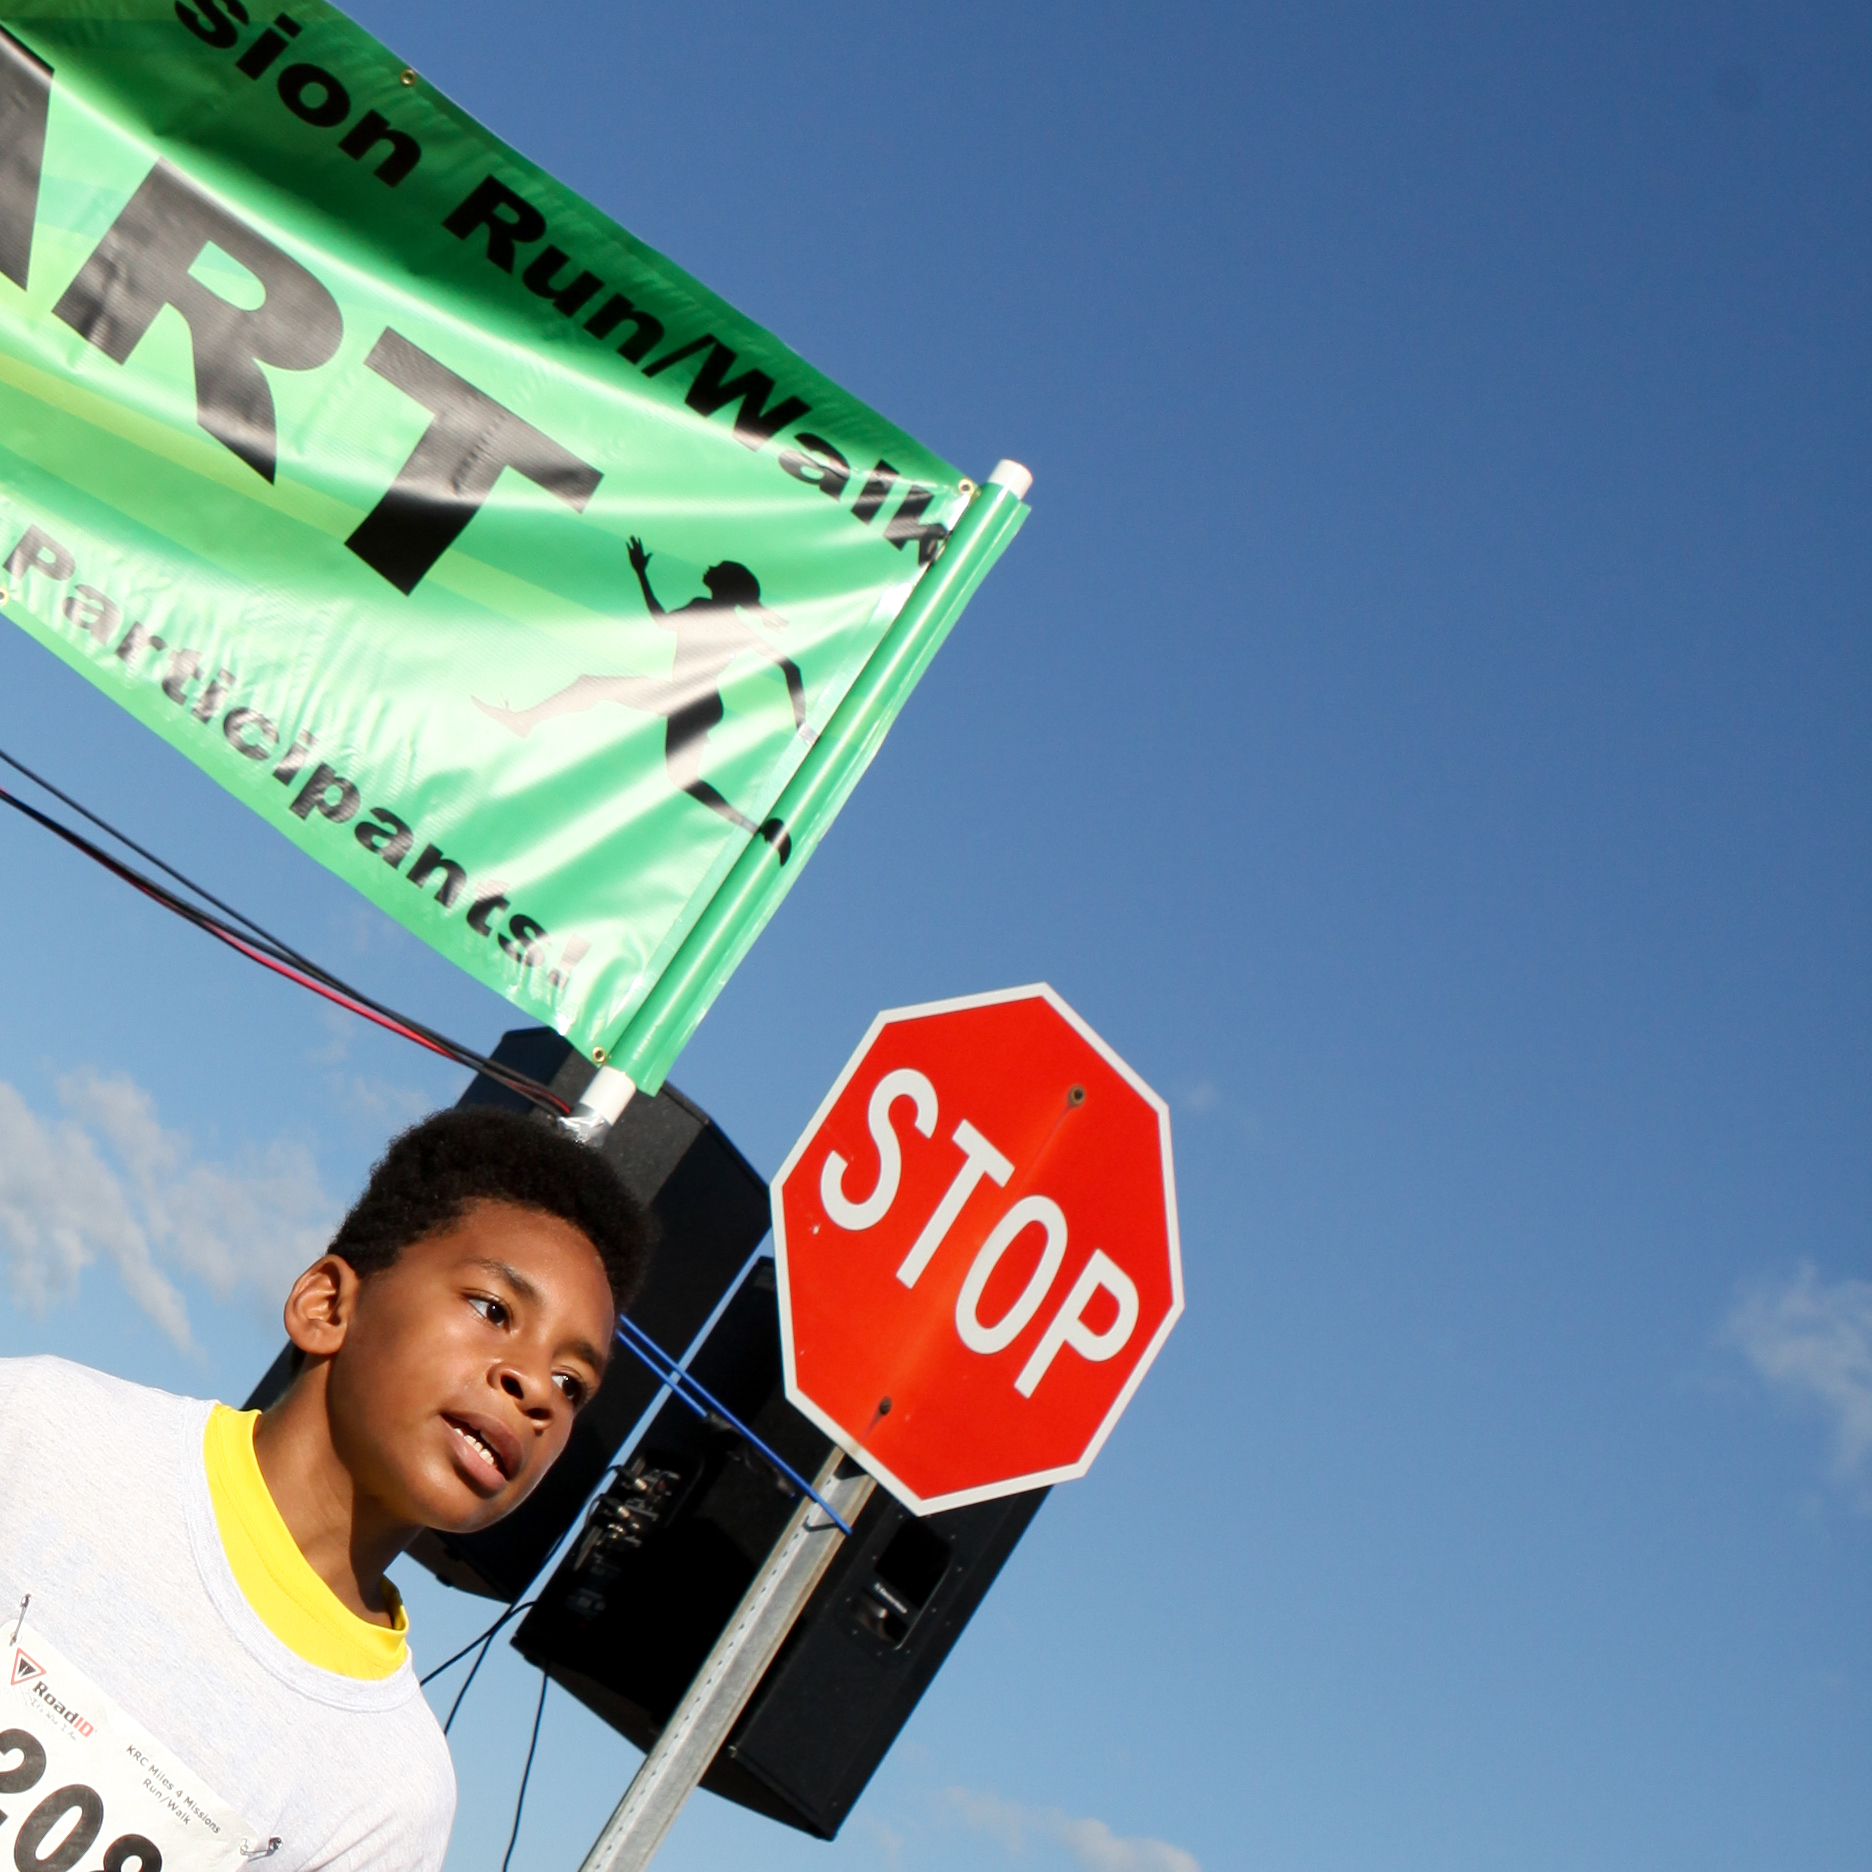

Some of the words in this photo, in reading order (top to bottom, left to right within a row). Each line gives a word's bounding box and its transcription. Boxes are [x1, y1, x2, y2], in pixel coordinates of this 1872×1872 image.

[440, 174, 950, 567] Run/Walk
[2, 524, 591, 989] Participants!
[819, 1067, 1140, 1400] STOP
[32, 1680, 95, 1738] RoadID
[126, 1744, 149, 1767] KRC
[148, 1764, 174, 1791] Miles
[175, 1789, 184, 1798] 4
[183, 1795, 221, 1834] Missions
[142, 1777, 191, 1825] Run/Walk
